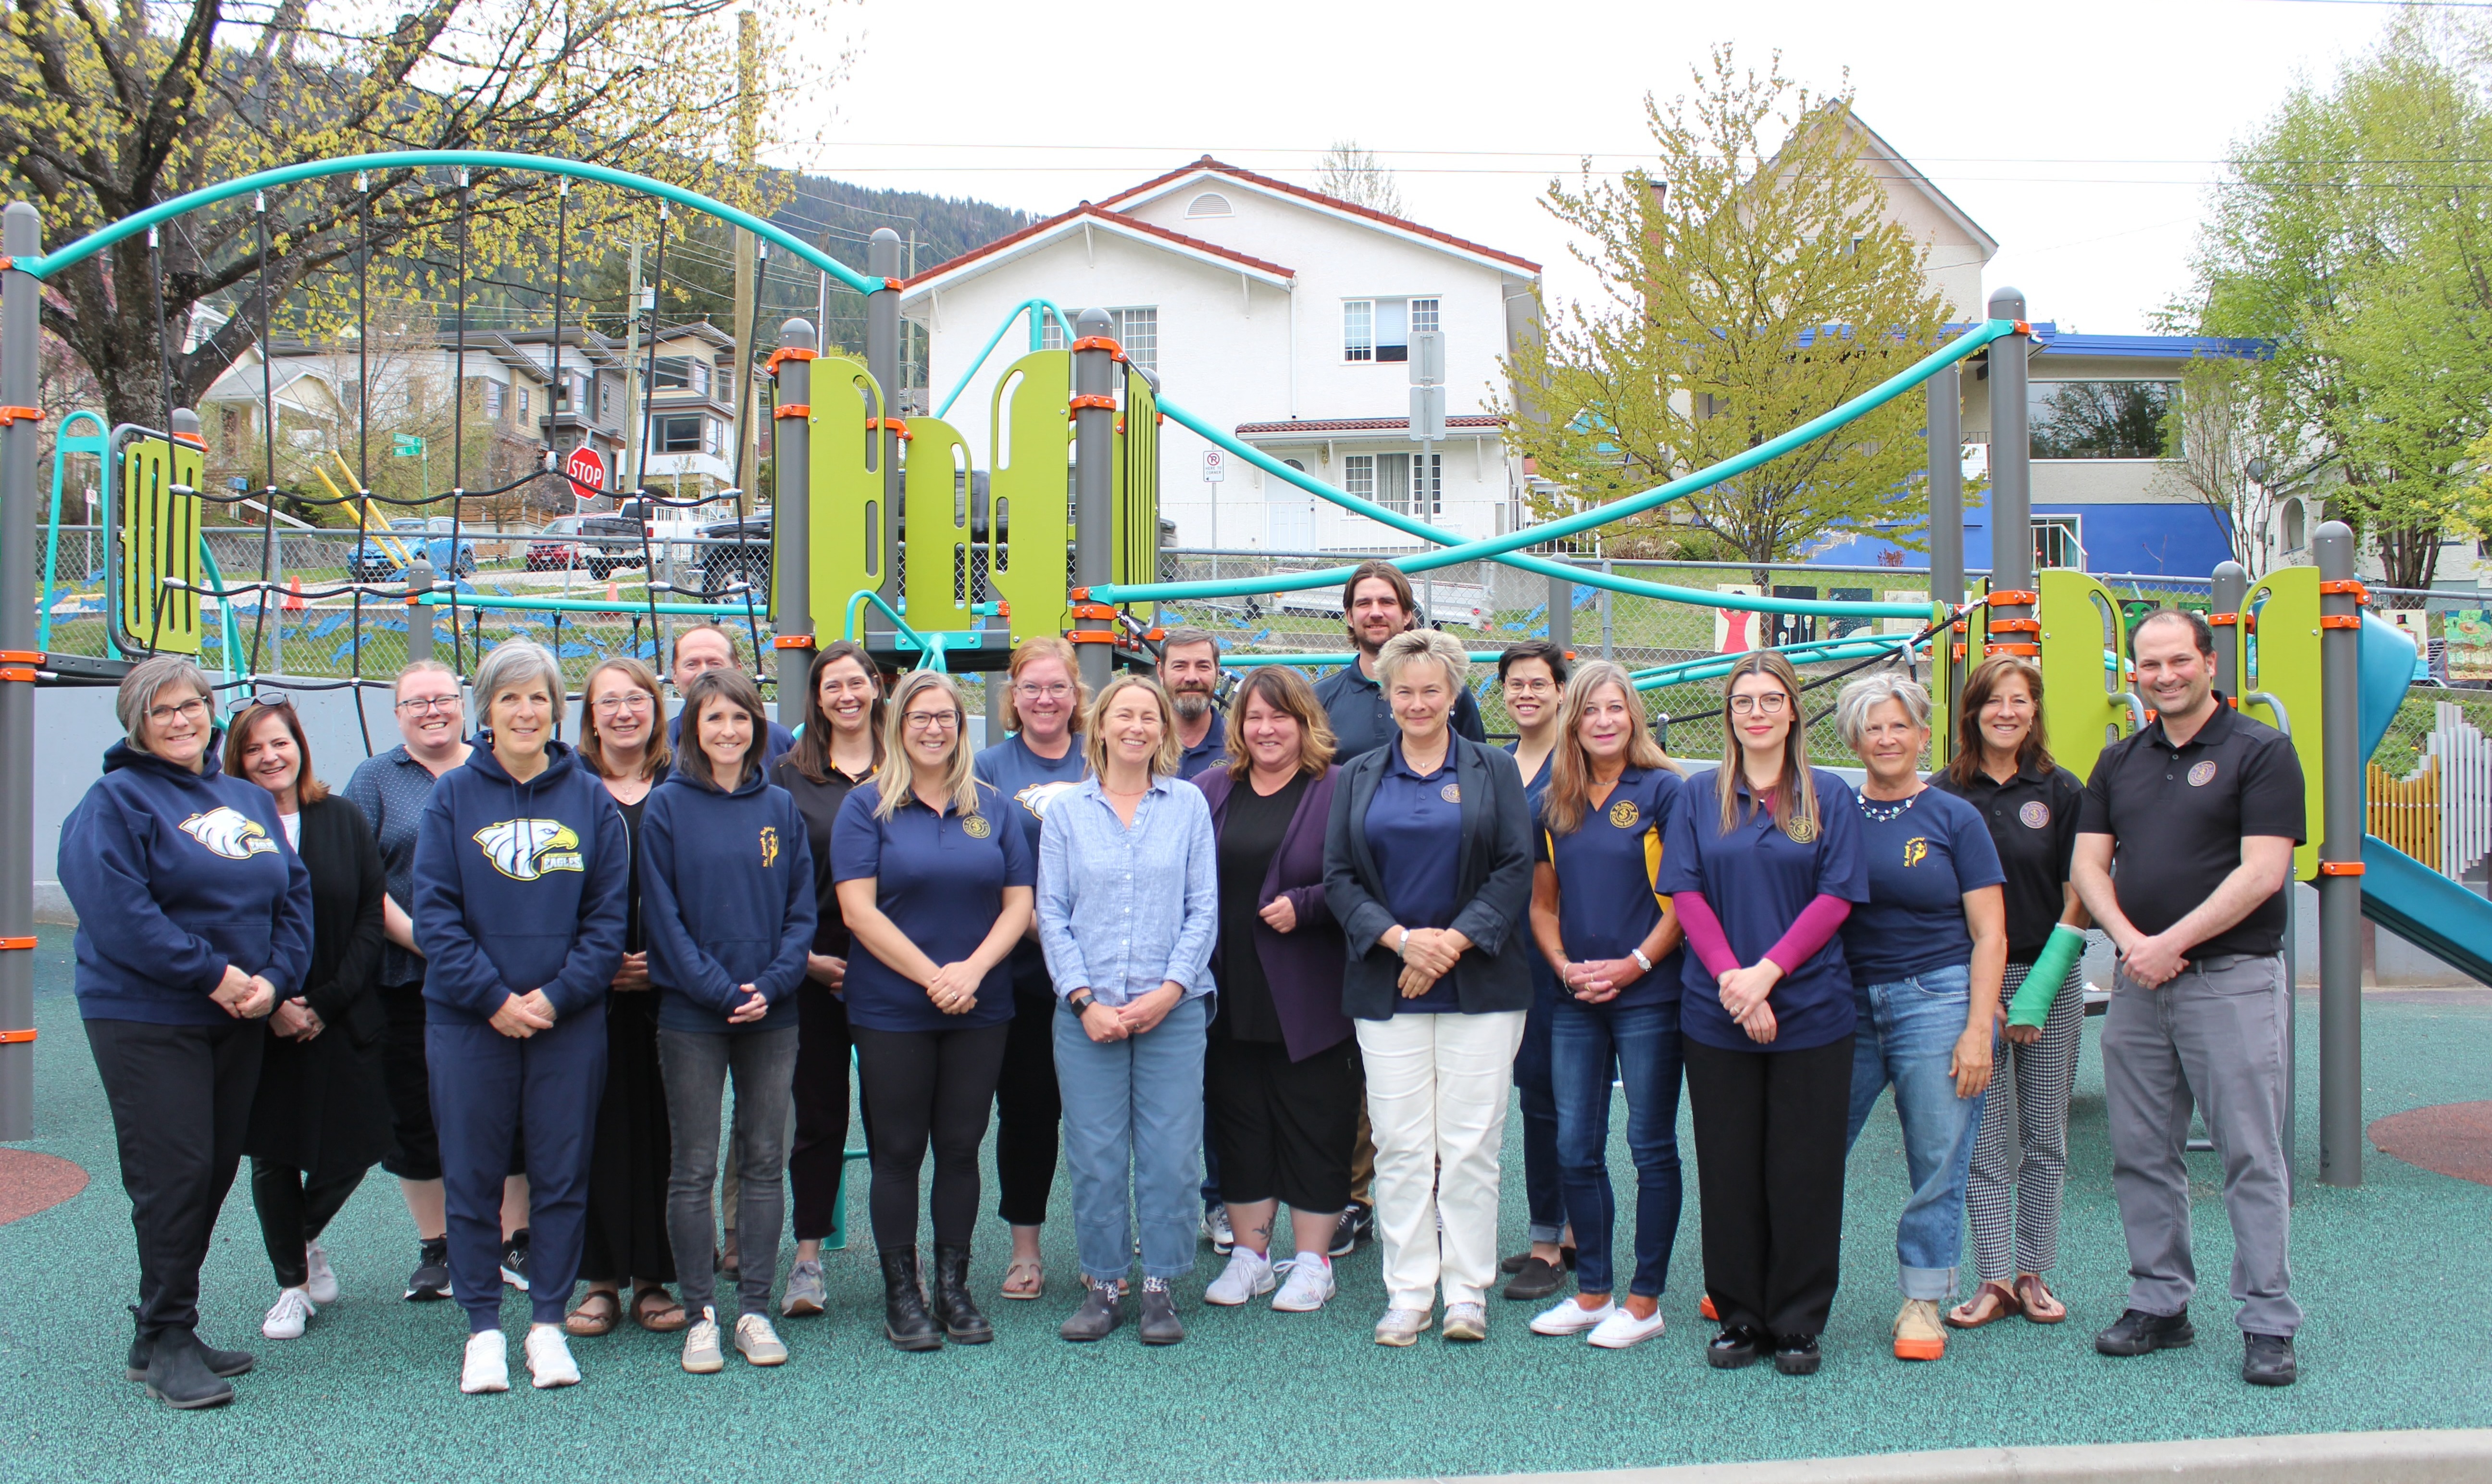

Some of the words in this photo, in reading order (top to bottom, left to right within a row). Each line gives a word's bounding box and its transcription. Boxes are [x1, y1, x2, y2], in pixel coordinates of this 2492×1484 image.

[395, 434, 415, 445] JOSEPHINE
[570, 459, 602, 486] STOP
[1620, 803, 1634, 811] Joseph
[760, 826, 775, 837] School
[1906, 837, 1925, 845] School
[543, 856, 582, 871] EAGLES
